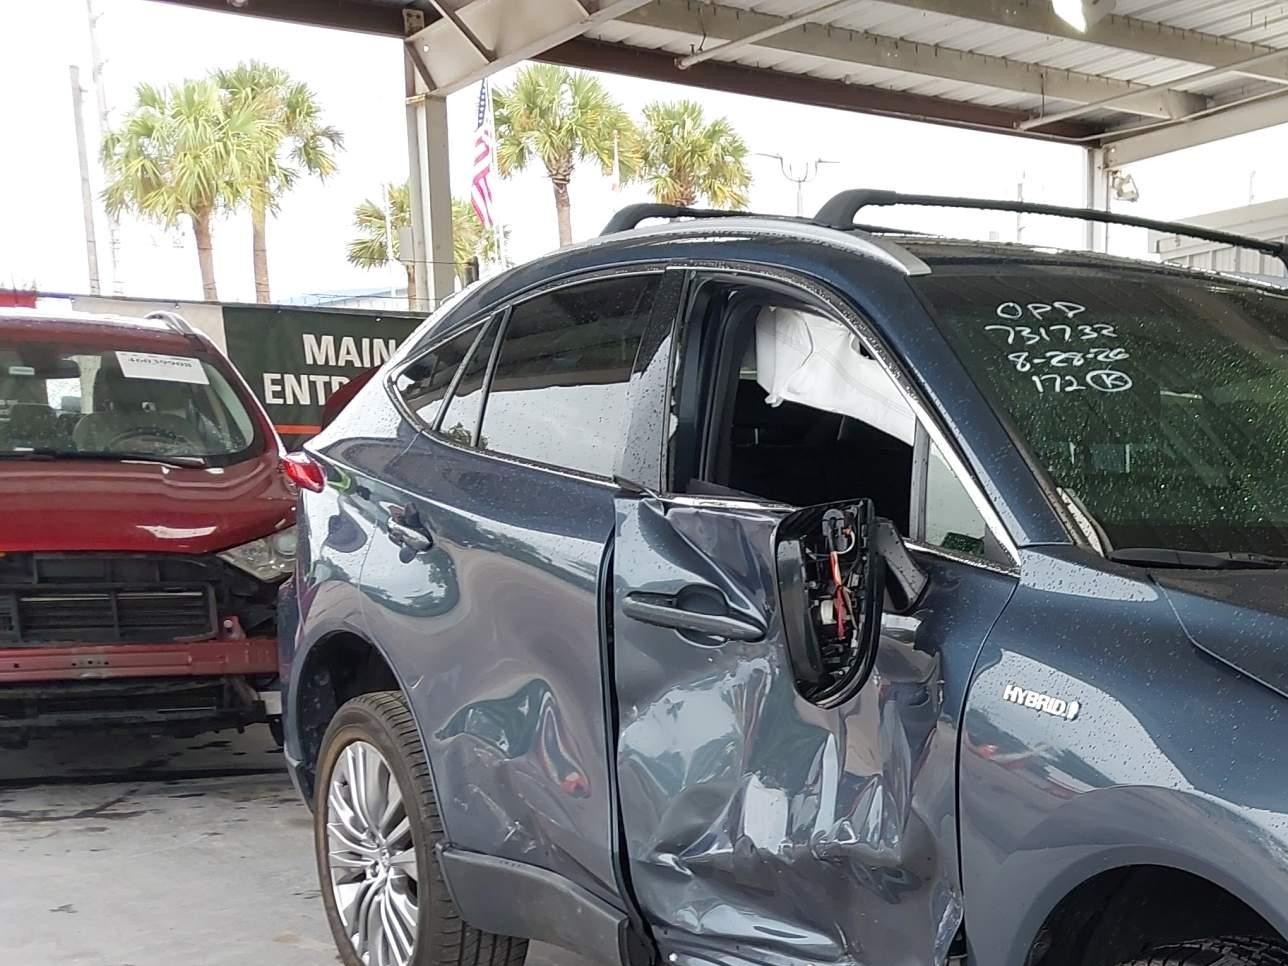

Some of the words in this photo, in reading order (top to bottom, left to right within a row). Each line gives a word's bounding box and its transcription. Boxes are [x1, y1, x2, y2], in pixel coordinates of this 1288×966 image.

[985, 324, 1118, 345] 731732
[302, 334, 397, 368] MAIN
[1008, 348, 1130, 372] 8-28-26
[1032, 374, 1087, 392] 172
[1003, 684, 1067, 718] HYBRID
